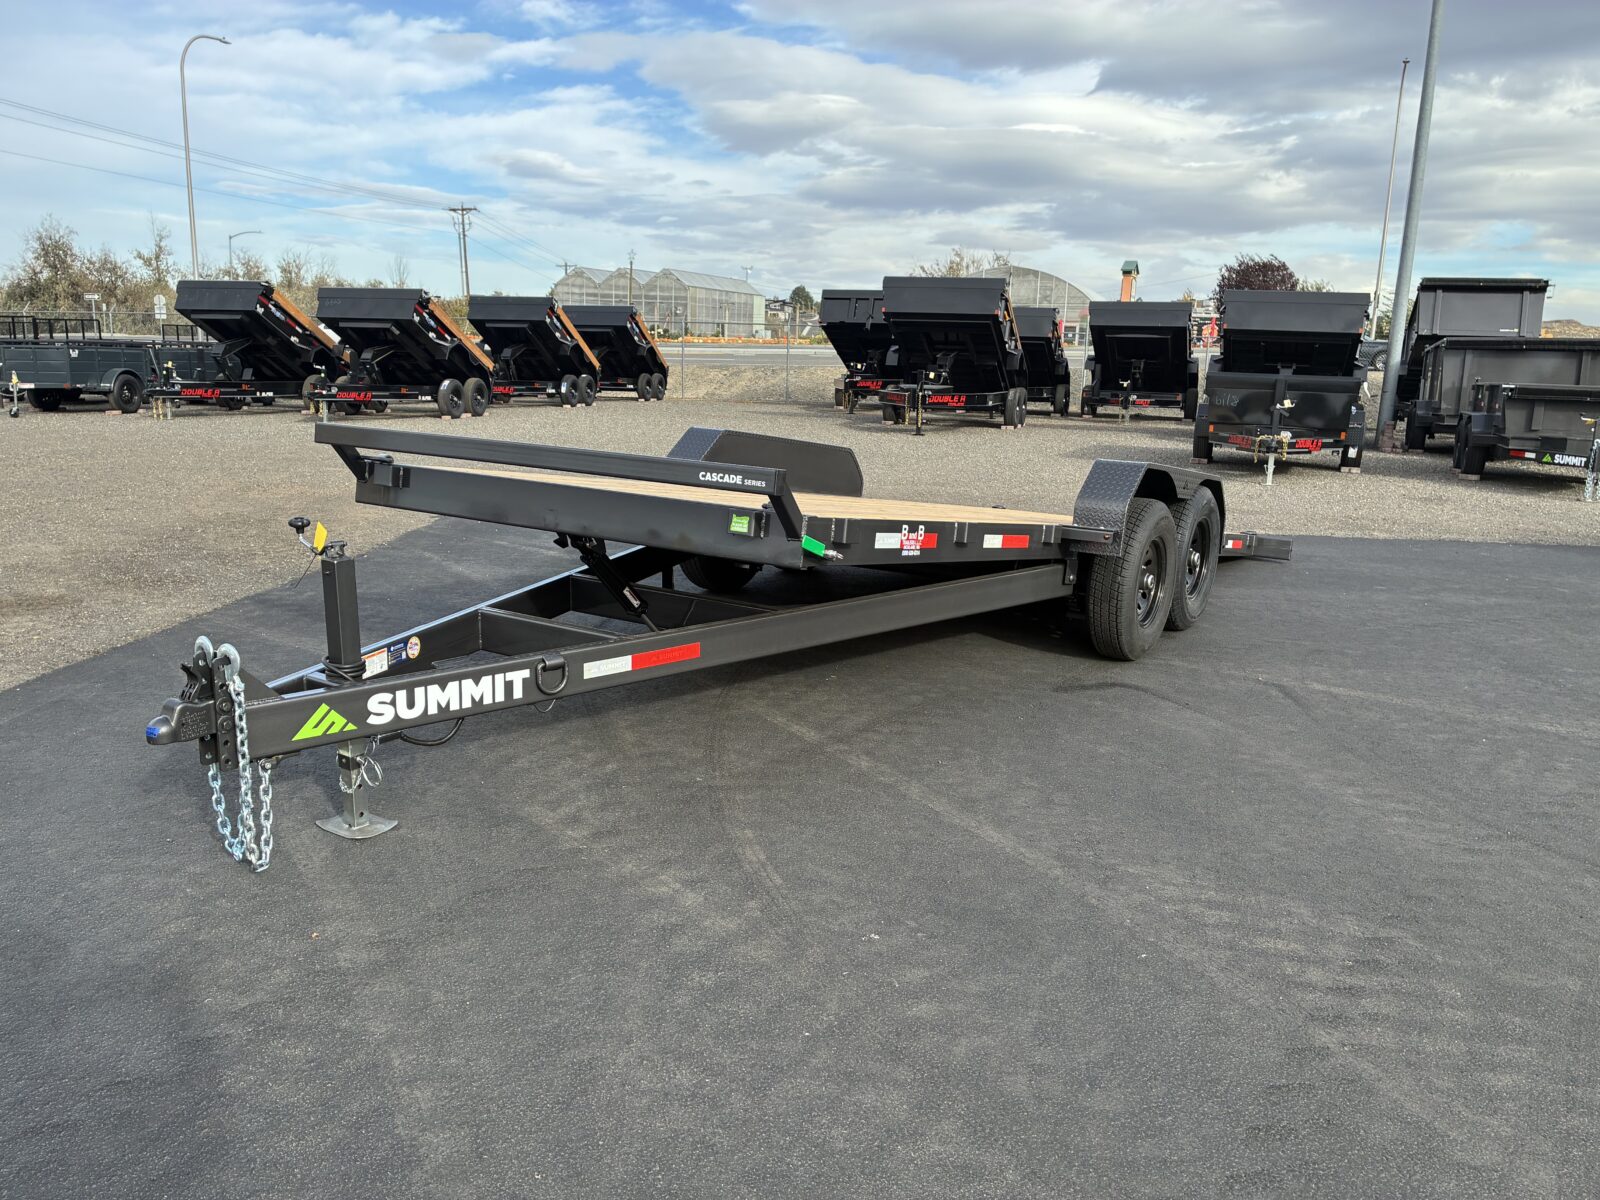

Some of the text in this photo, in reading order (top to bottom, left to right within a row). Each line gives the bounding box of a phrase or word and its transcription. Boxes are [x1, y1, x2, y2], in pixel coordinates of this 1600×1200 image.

[1554, 454, 1587, 467] SUMMIT
[699, 472, 766, 488] CASCADE SERIES
[901, 524, 909, 540] B
[918, 525, 925, 540] B
[366, 669, 530, 725] SUMMIT
